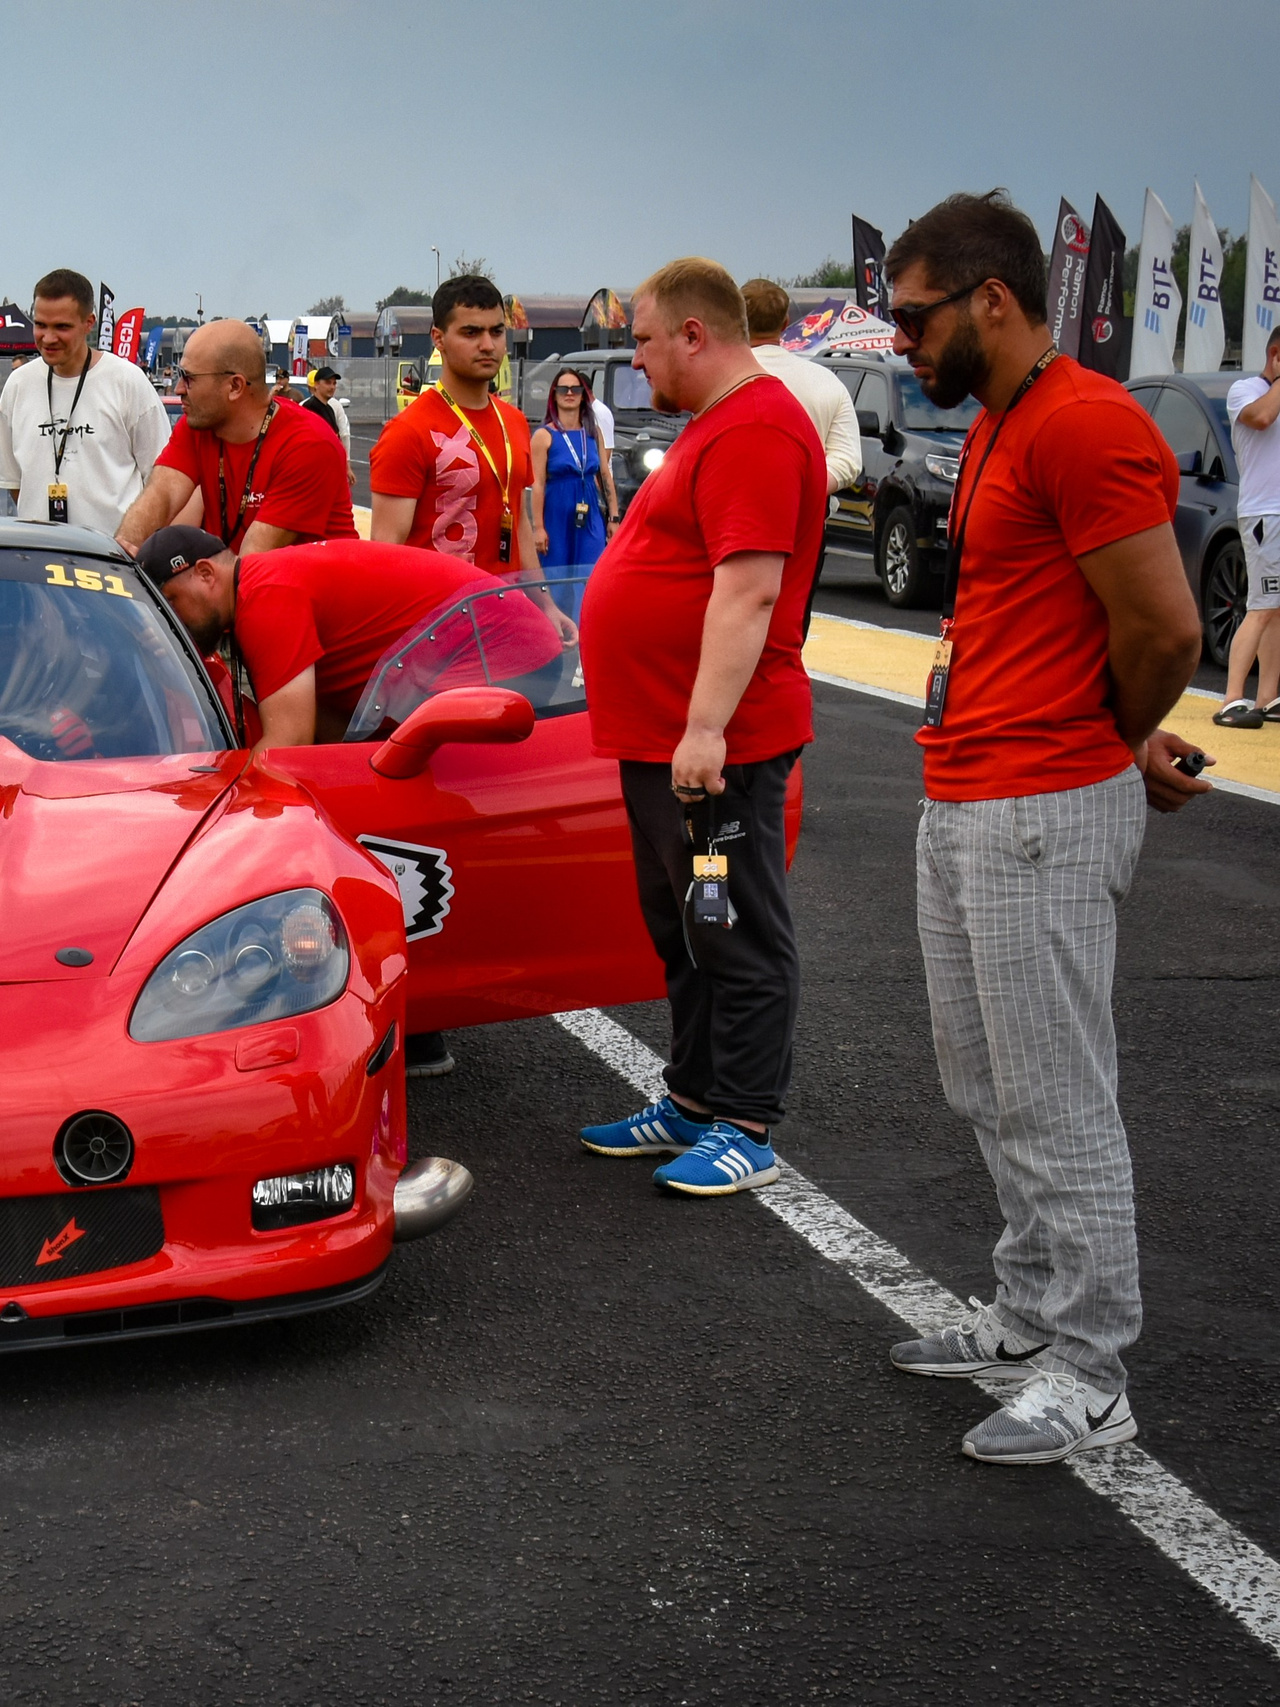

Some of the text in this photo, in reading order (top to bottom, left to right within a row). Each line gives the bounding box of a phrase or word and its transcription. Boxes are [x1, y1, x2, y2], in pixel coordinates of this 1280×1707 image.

[1070, 258, 1085, 319] Ramon
[1097, 279, 1108, 313] Ramon
[118, 315, 135, 361] SOL
[836, 338, 894, 350] MOTUL
[45, 564, 133, 598] 151
